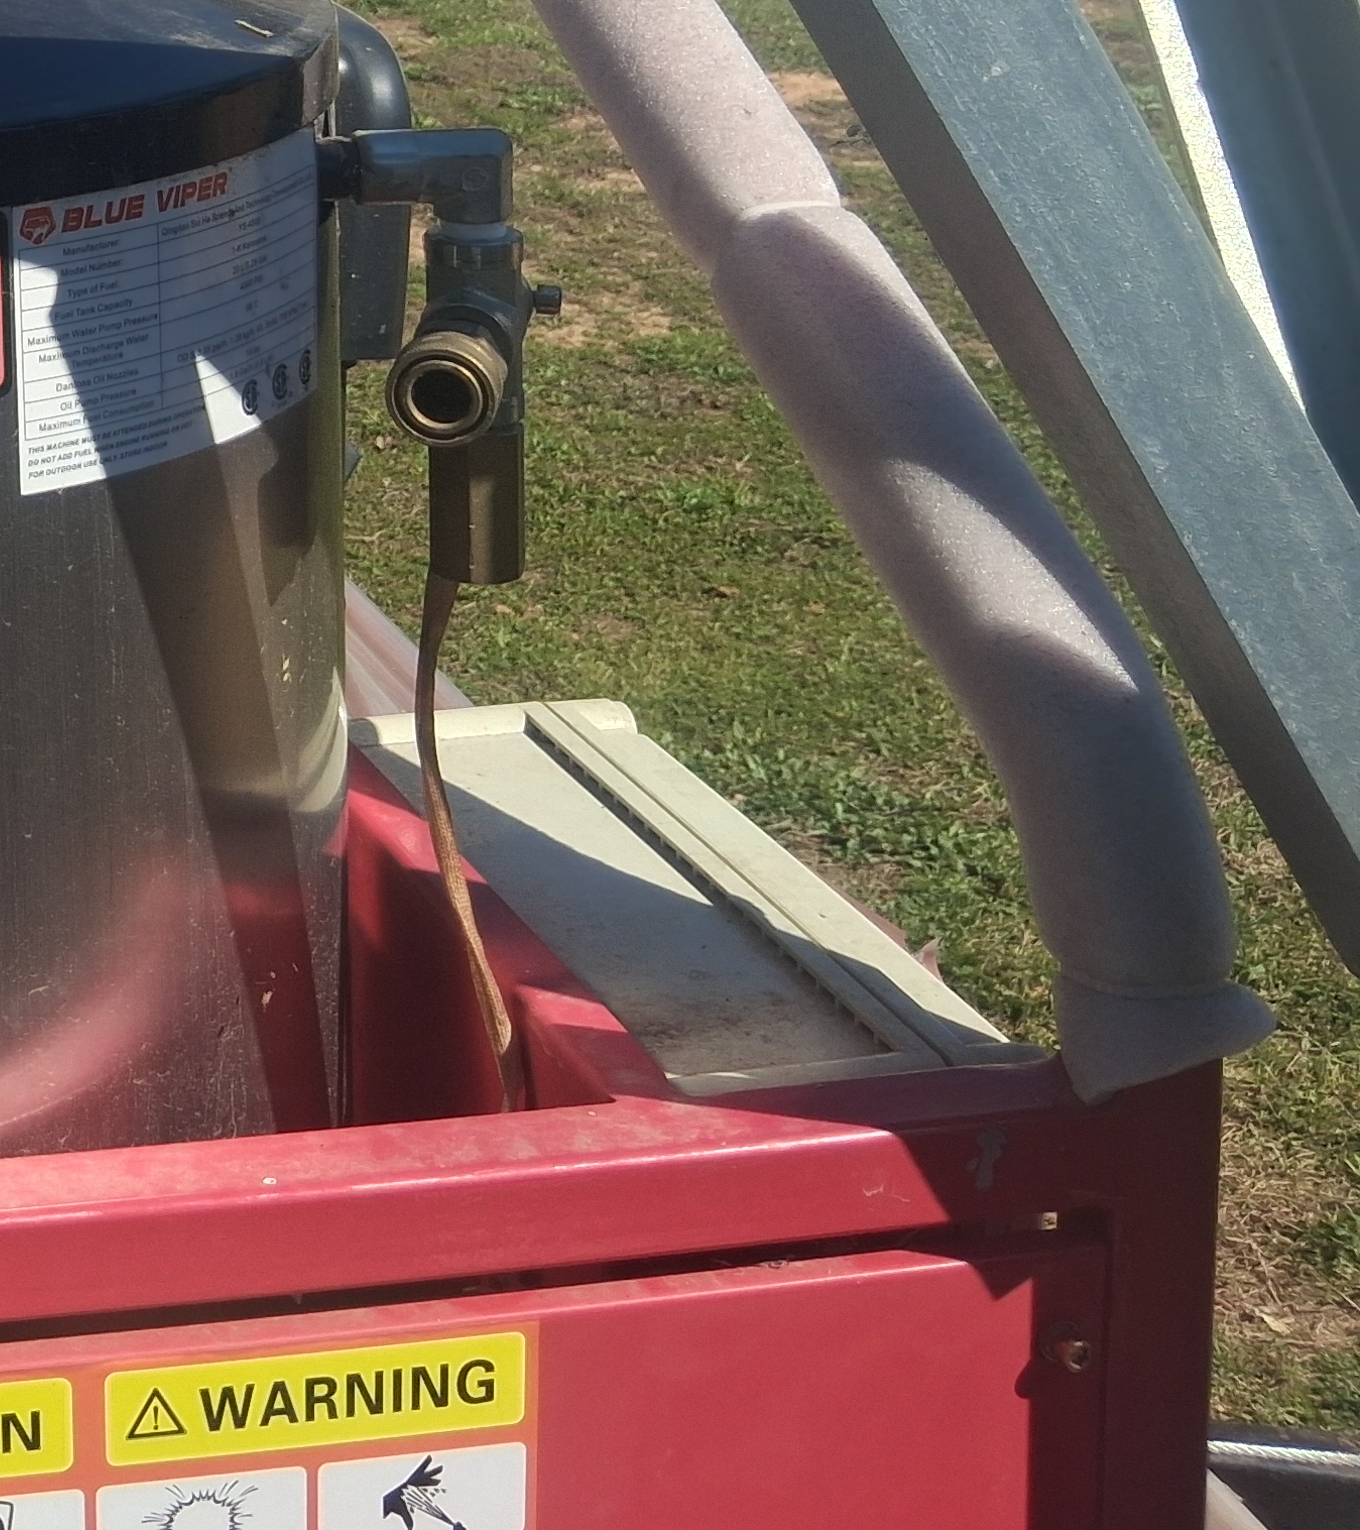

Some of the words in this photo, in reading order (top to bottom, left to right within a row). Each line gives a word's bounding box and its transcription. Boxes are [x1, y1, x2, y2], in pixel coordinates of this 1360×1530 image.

[61, 194, 146, 233] BLUE
[156, 172, 228, 213] VIPER
[63, 239, 121, 256] Manufacturer:
[61, 265, 87, 277] Model
[68, 287, 88, 299] Type
[89, 284, 99, 295] of
[54, 307, 74, 320] Fuel
[76, 303, 95, 317] Tank
[97, 298, 133, 313] Capacity
[27, 330, 70, 346] Maximum
[72, 325, 97, 339] Water
[98, 321, 122, 336] Pump
[124, 313, 159, 328] Pressure
[39, 348, 80, 363] Maximum
[82, 339, 124, 356] Discharge
[125, 333, 149, 346] Water
[71, 352, 124, 369] Temperature
[100, 388, 137, 404] Pressure
[39, 417, 81, 432] Maximum
[103, 400, 155, 419] Consumption
[198, 1356, 499, 1435] WARNING
